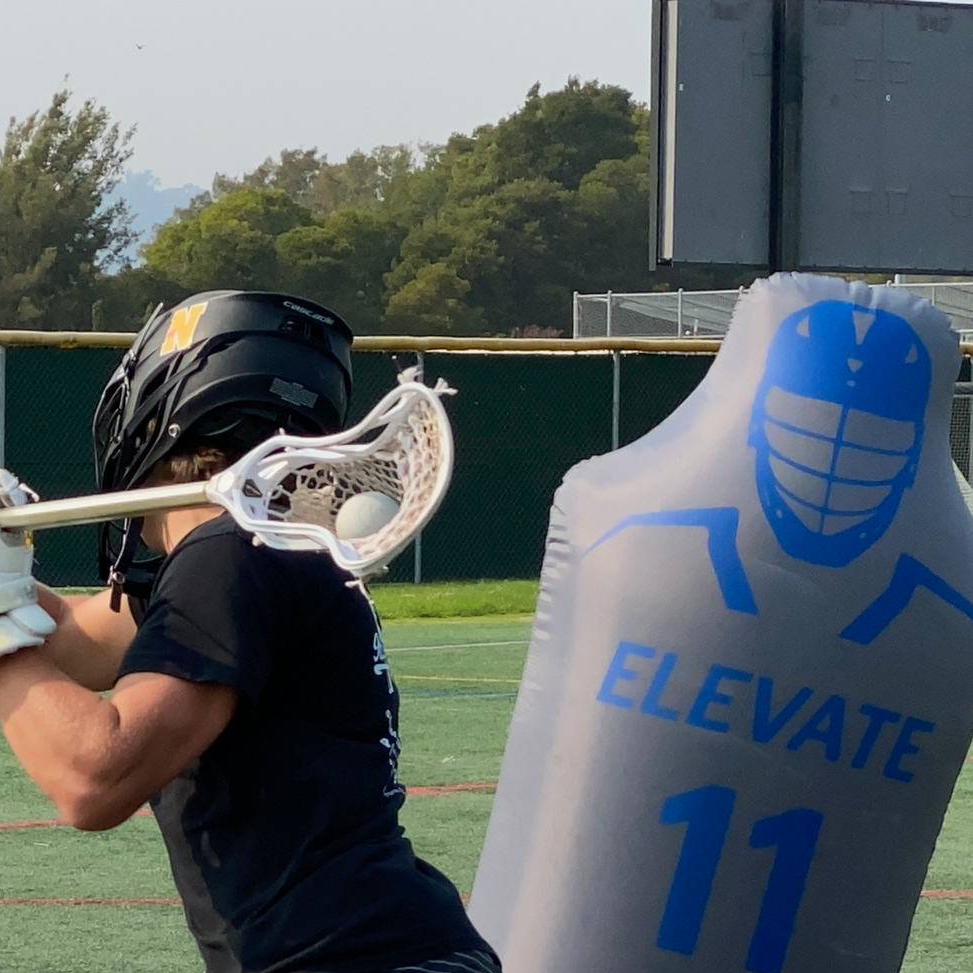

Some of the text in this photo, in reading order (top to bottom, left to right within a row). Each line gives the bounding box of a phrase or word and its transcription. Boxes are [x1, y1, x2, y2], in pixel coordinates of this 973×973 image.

[159, 300, 209, 357] N
[282, 300, 335, 326] cascade
[595, 640, 936, 784] ELEVATE
